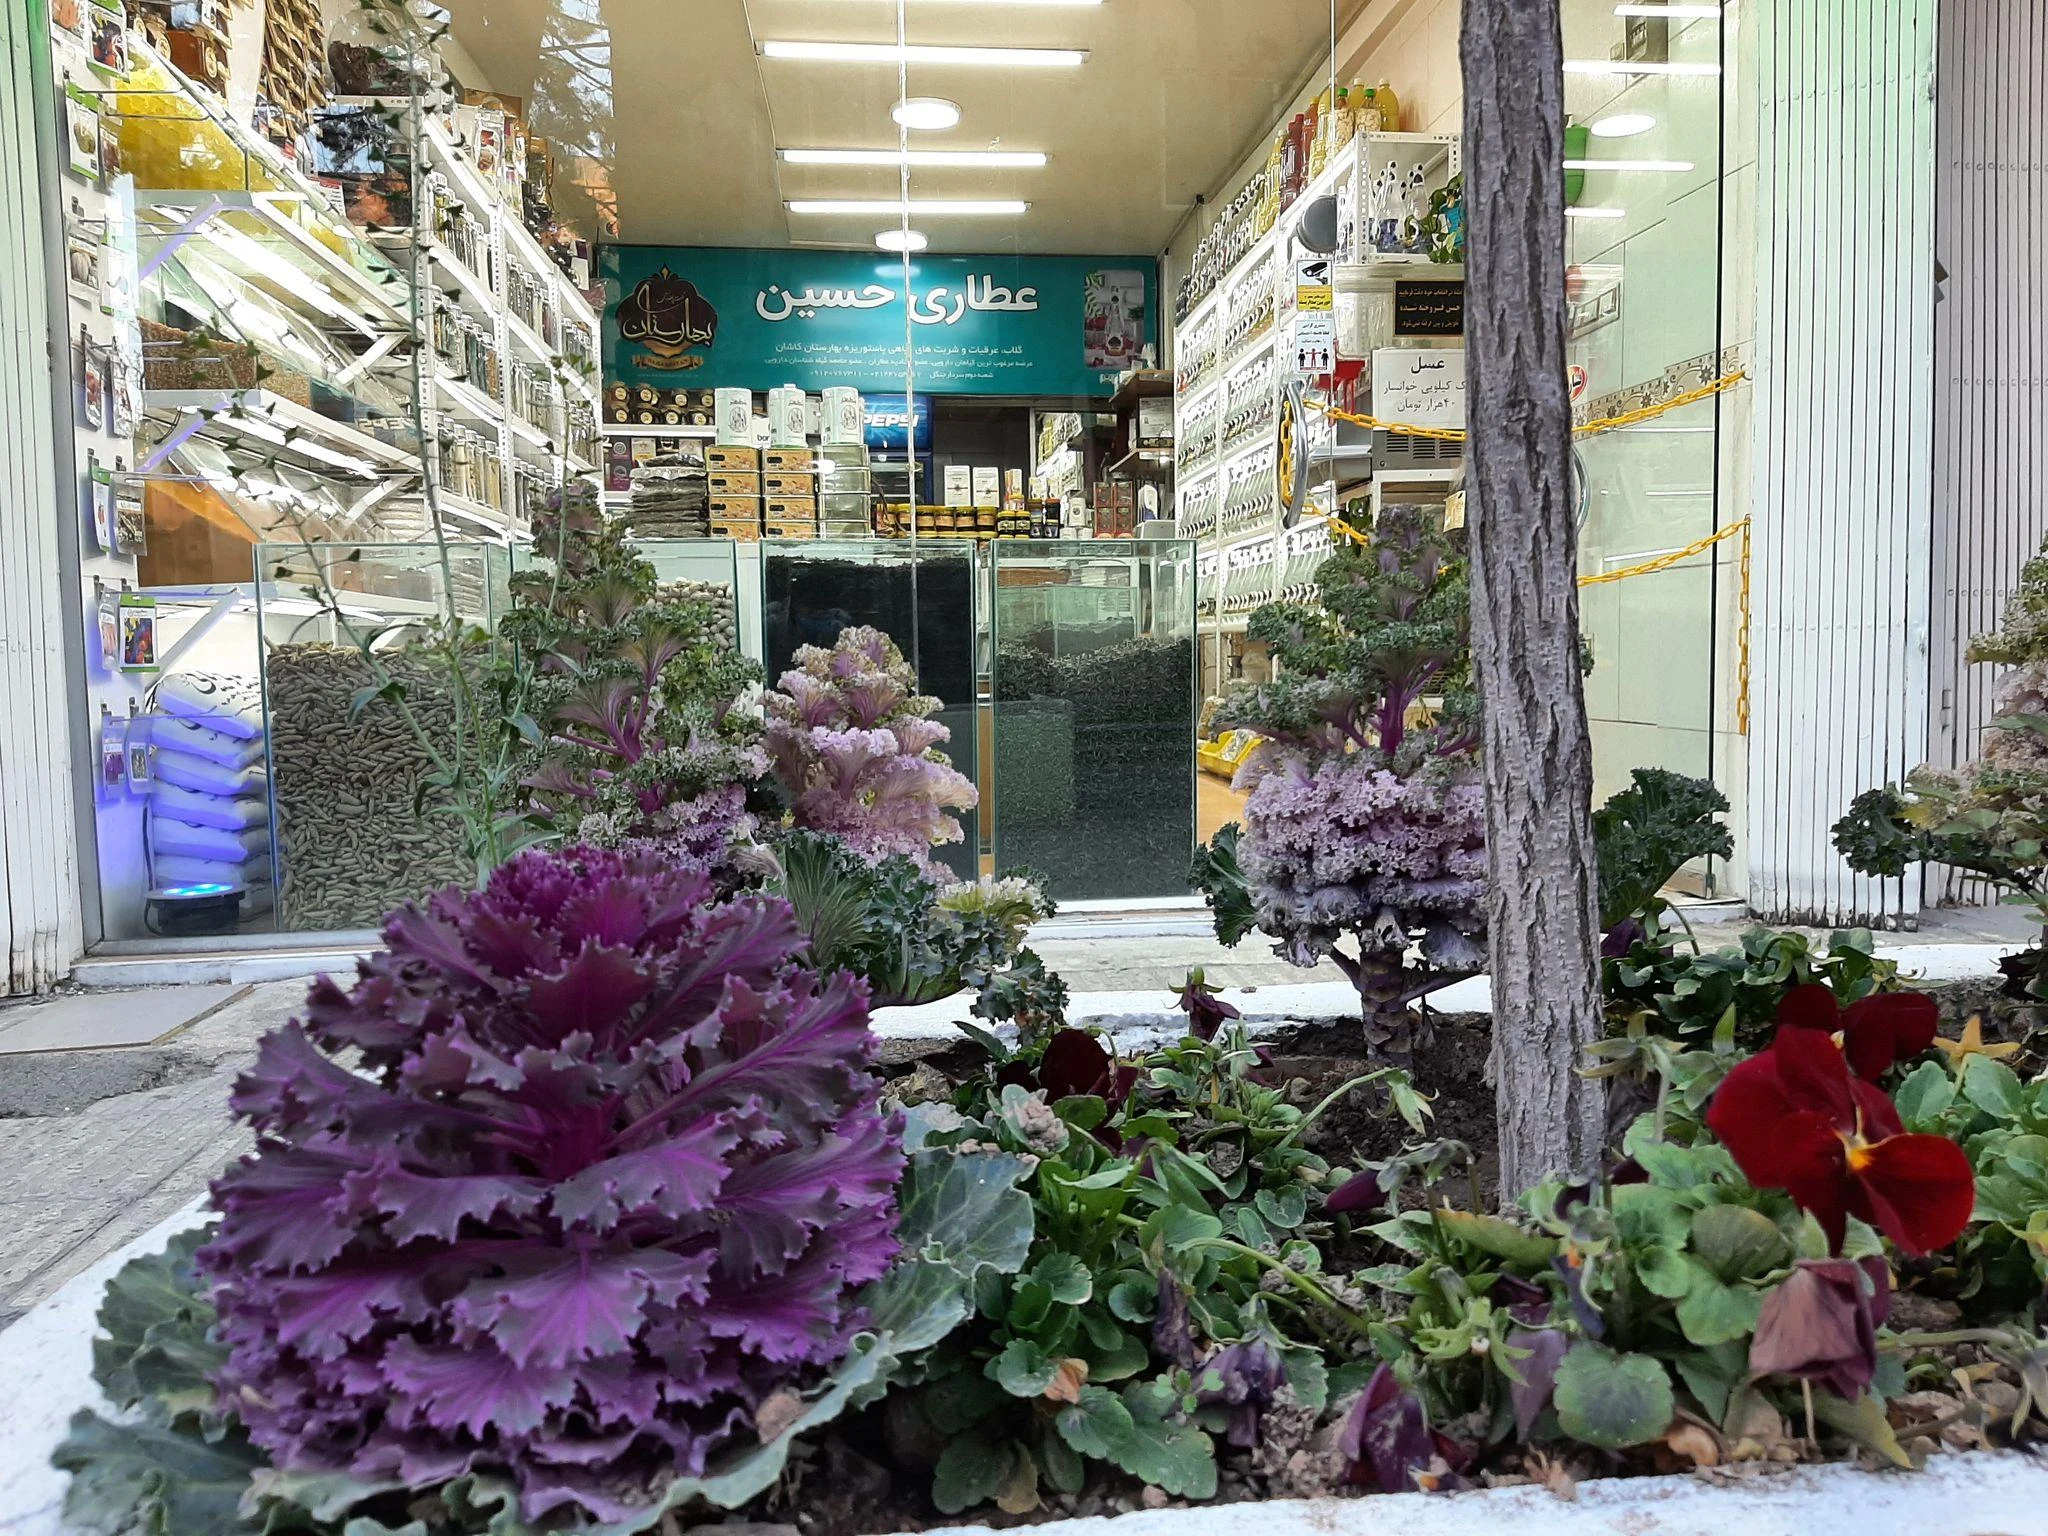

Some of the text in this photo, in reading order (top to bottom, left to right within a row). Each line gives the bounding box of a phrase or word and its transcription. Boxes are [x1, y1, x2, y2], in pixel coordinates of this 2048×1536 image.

[755, 273, 1039, 325] عطاری حسین
[622, 282, 713, 347] بهارستان
[775, 342, 802, 352] کاشان
[1410, 356, 1445, 374] عسل
[1384, 380, 1418, 395] خوانسار
[1421, 379, 1452, 395] کیلویی
[1397, 398, 1421, 412] تومان
[863, 413, 920, 428] PEPSI
